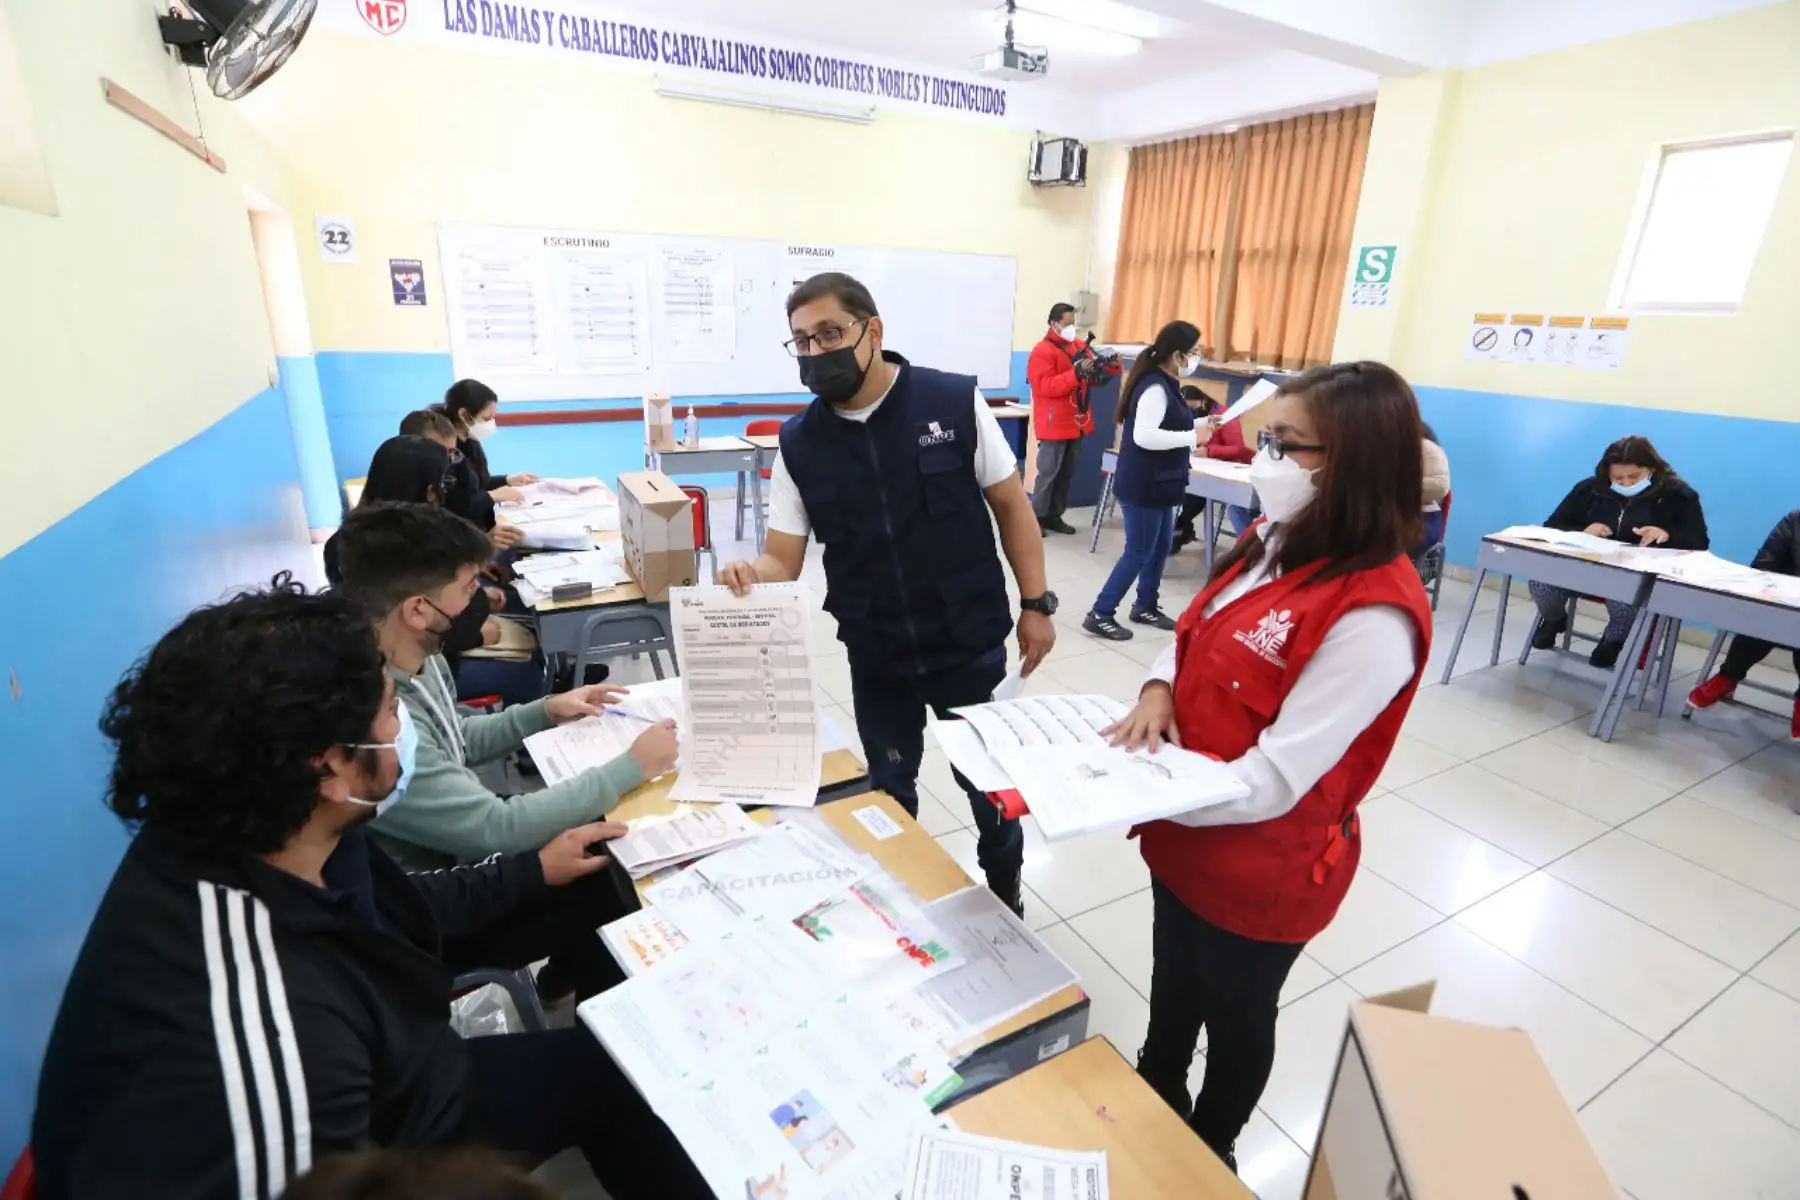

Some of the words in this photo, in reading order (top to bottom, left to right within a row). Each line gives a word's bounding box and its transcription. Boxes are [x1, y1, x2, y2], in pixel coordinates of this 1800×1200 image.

[366, 2, 400, 29] MC
[444, 0, 477, 34] LAS
[479, 0, 541, 45] DAMAS
[543, 10, 555, 46] Y
[558, 14, 659, 62] CABALLEROS
[661, 31, 767, 78] CARVAJALINOS
[768, 48, 812, 84] SOMOS
[814, 56, 875, 96] CORTESES
[876, 67, 920, 102] NOBLES
[922, 74, 932, 104] Y
[932, 76, 1006, 116] DISTINGUIDOS
[324, 230, 349, 245] 22
[543, 236, 610, 249] ESCRUTINIO
[788, 245, 835, 258] SUFRAGIO
[1361, 248, 1389, 282] S
[1249, 627, 1283, 653] JNE
